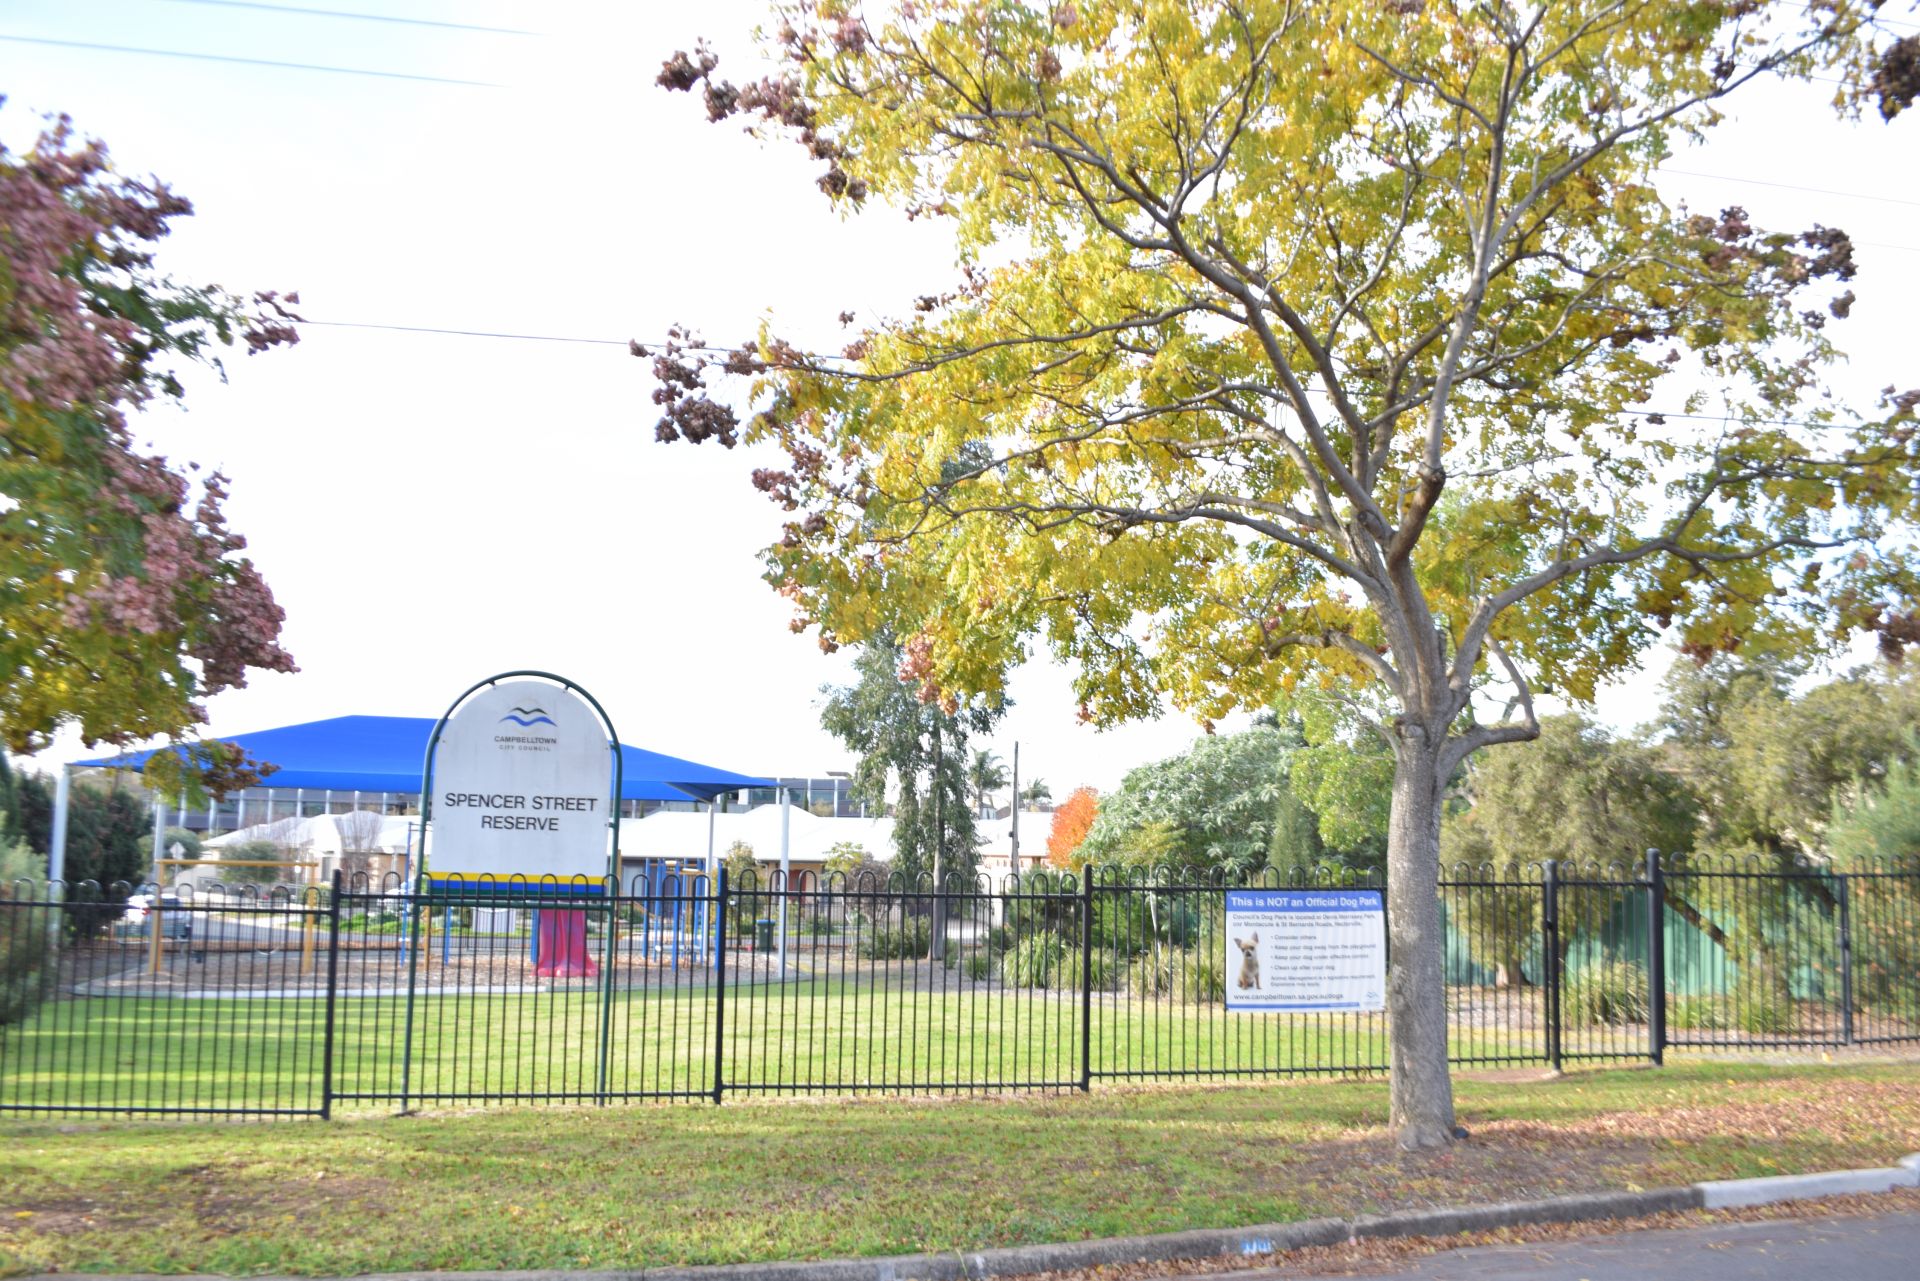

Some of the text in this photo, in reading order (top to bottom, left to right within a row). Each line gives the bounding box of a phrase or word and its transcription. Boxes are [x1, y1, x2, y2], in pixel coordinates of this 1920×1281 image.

[494, 735, 557, 744] CAMPBELLTOWN
[445, 792, 598, 811] SPENCER STREET
[481, 815, 559, 831] RESERVE
[1231, 896, 1379, 909] This is NOT an Official Dog Park
[1261, 913, 1273, 921] Dog
